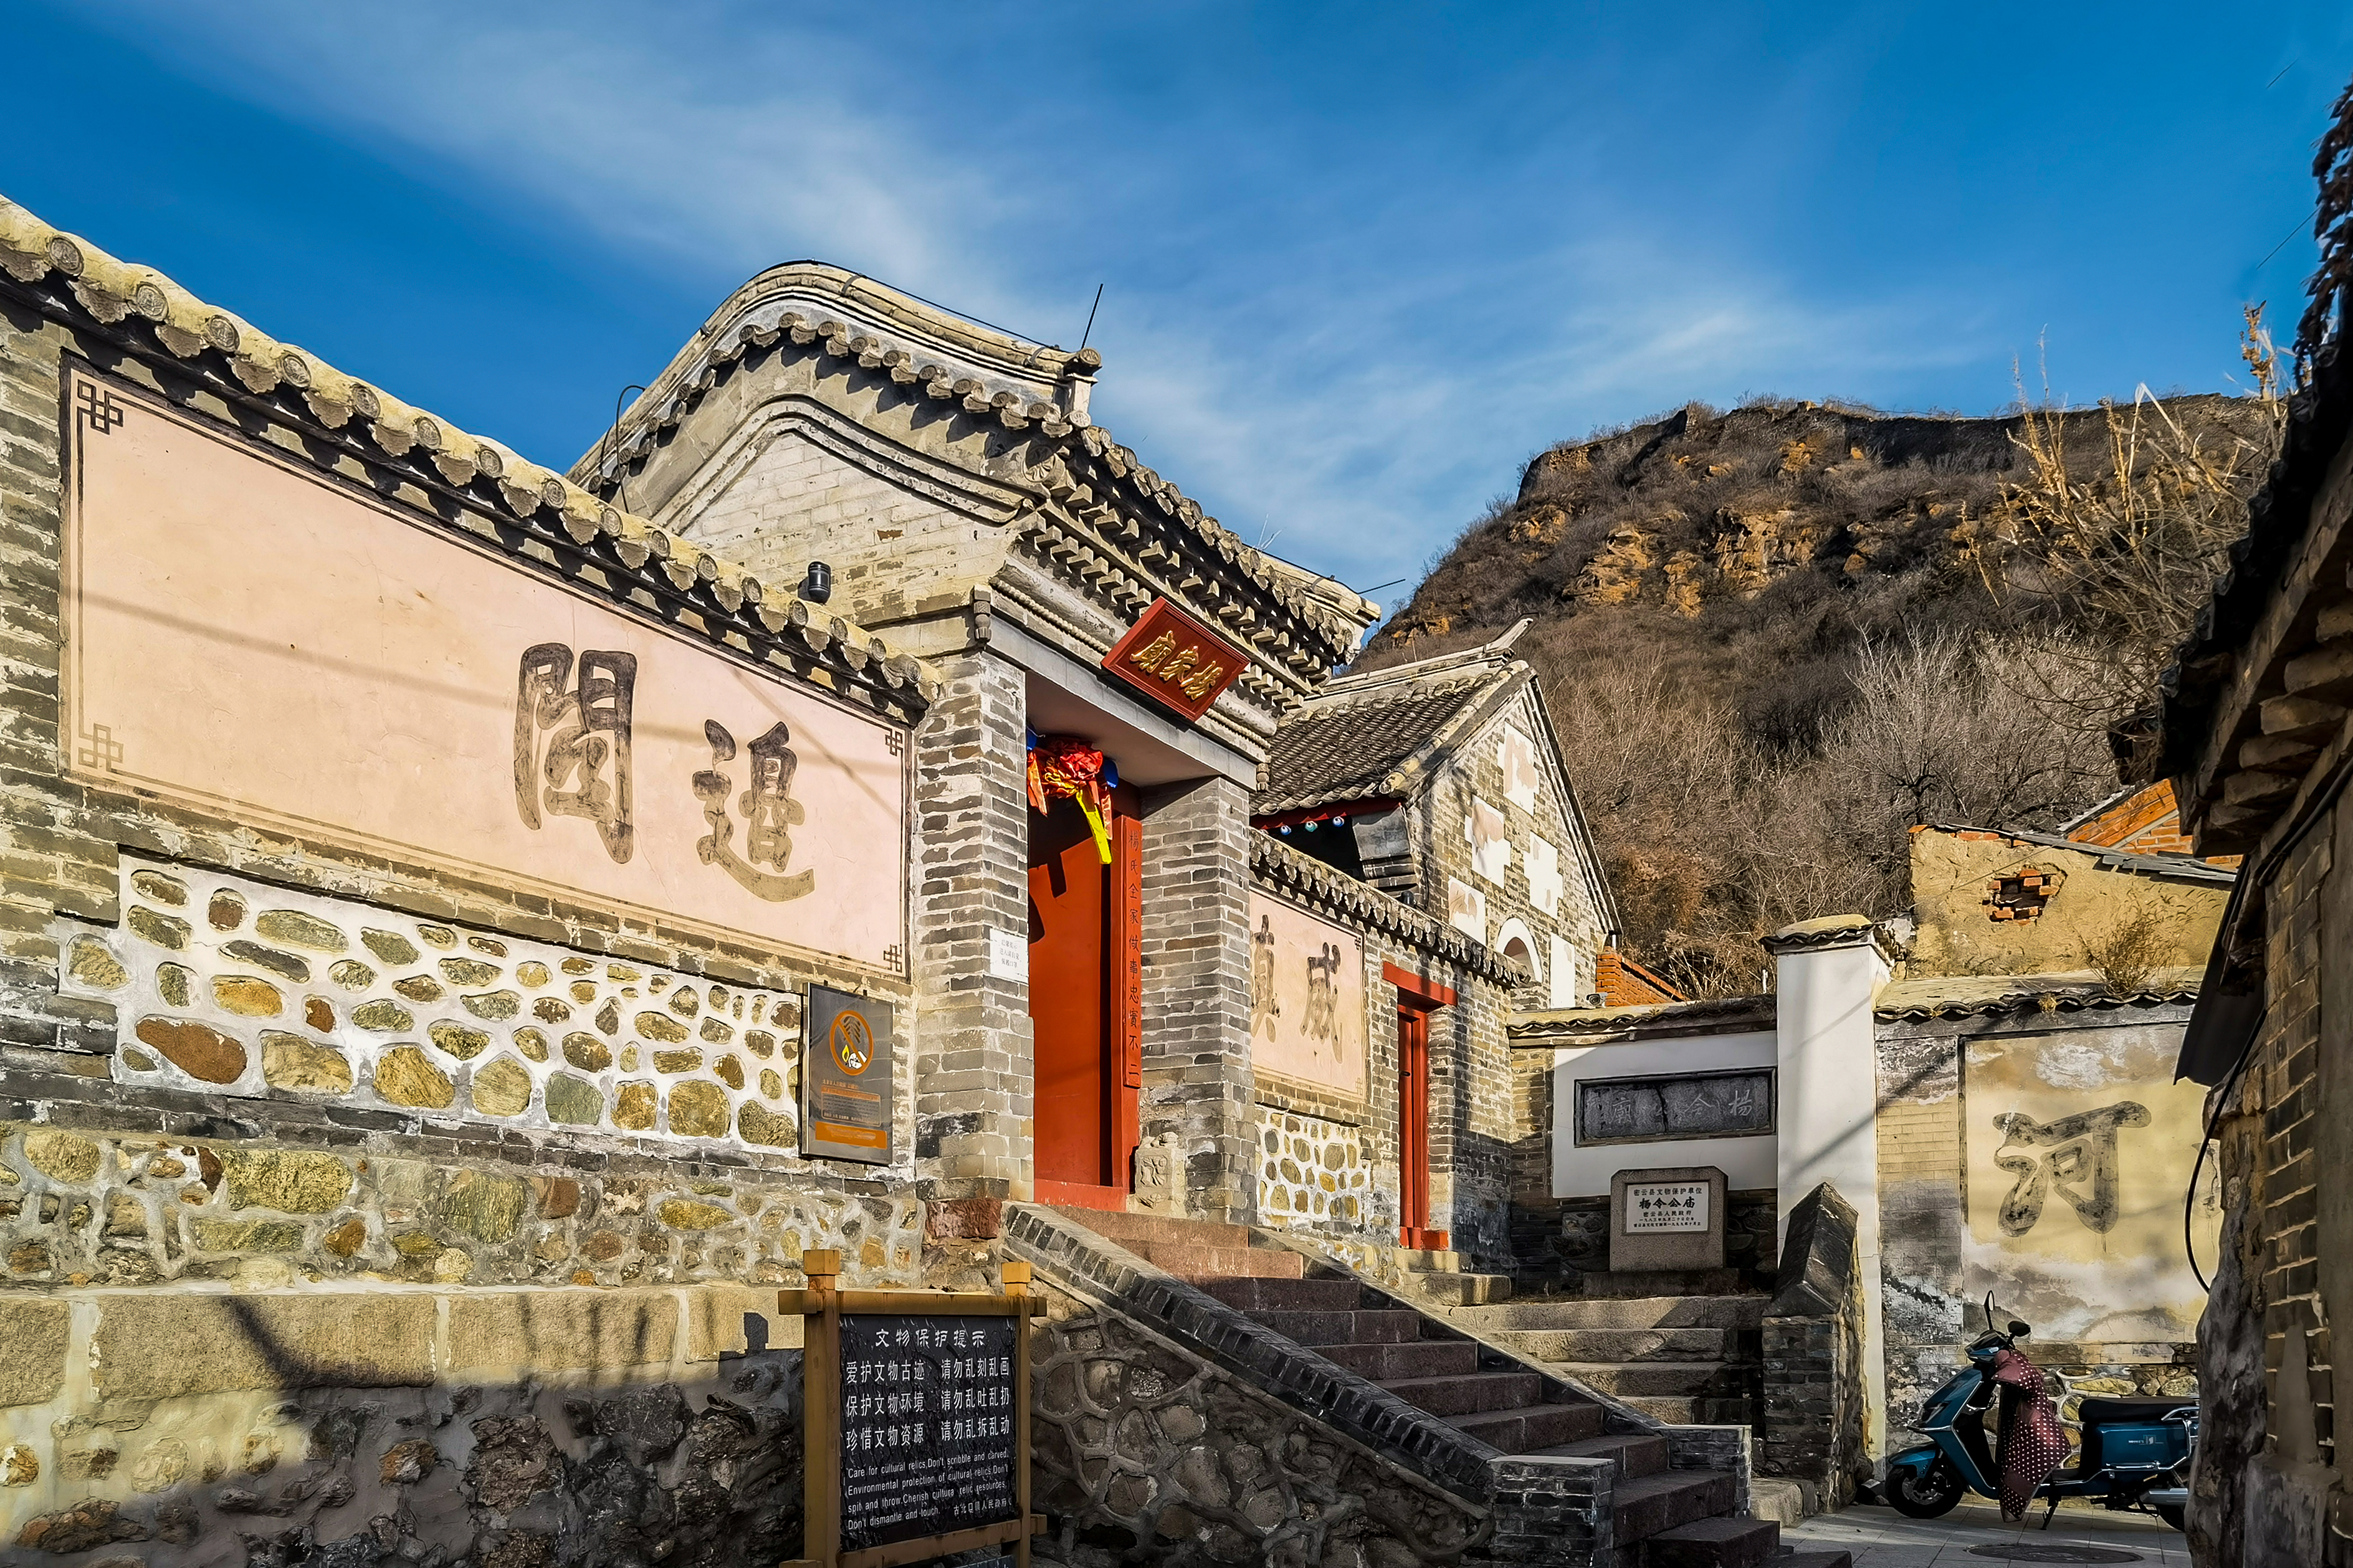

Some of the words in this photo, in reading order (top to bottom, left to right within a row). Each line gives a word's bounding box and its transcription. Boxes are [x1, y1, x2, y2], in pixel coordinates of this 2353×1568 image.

[1993, 1101, 2152, 1238] 河
[1633, 1187, 1702, 1196] 密云县文物保护单位
[1639, 1196, 1695, 1209] 杨令公庙
[876, 1329, 985, 1347] 文物保护提示
[846, 1359, 924, 1383] 爱护文物古迹
[941, 1357, 1009, 1379] 请勿乱刻乱画
[846, 1391, 924, 1417] 保护文物环境
[941, 1386, 1009, 1410] 请勿乱吐乱扔
[846, 1423, 924, 1452] 珍惜文物资源
[941, 1415, 1009, 1441] 请勿乱拆乱动
[848, 1468, 865, 1478] Care
[869, 1466, 877, 1475] for
[881, 1461, 905, 1474] cultural
[947, 1454, 971, 1465] scribble
[974, 1452, 985, 1461] and
[848, 1479, 899, 1496] Environmental
[902, 1475, 935, 1490] protection
[938, 1473, 945, 1482] of
[948, 1469, 971, 1481] cultural
[848, 1501, 862, 1514] spit
[865, 1498, 878, 1510] and
[960, 1485, 973, 1494] relic
[848, 1518, 866, 1529] Don't
[870, 1512, 902, 1526] dismantle
[905, 1509, 917, 1519] and
